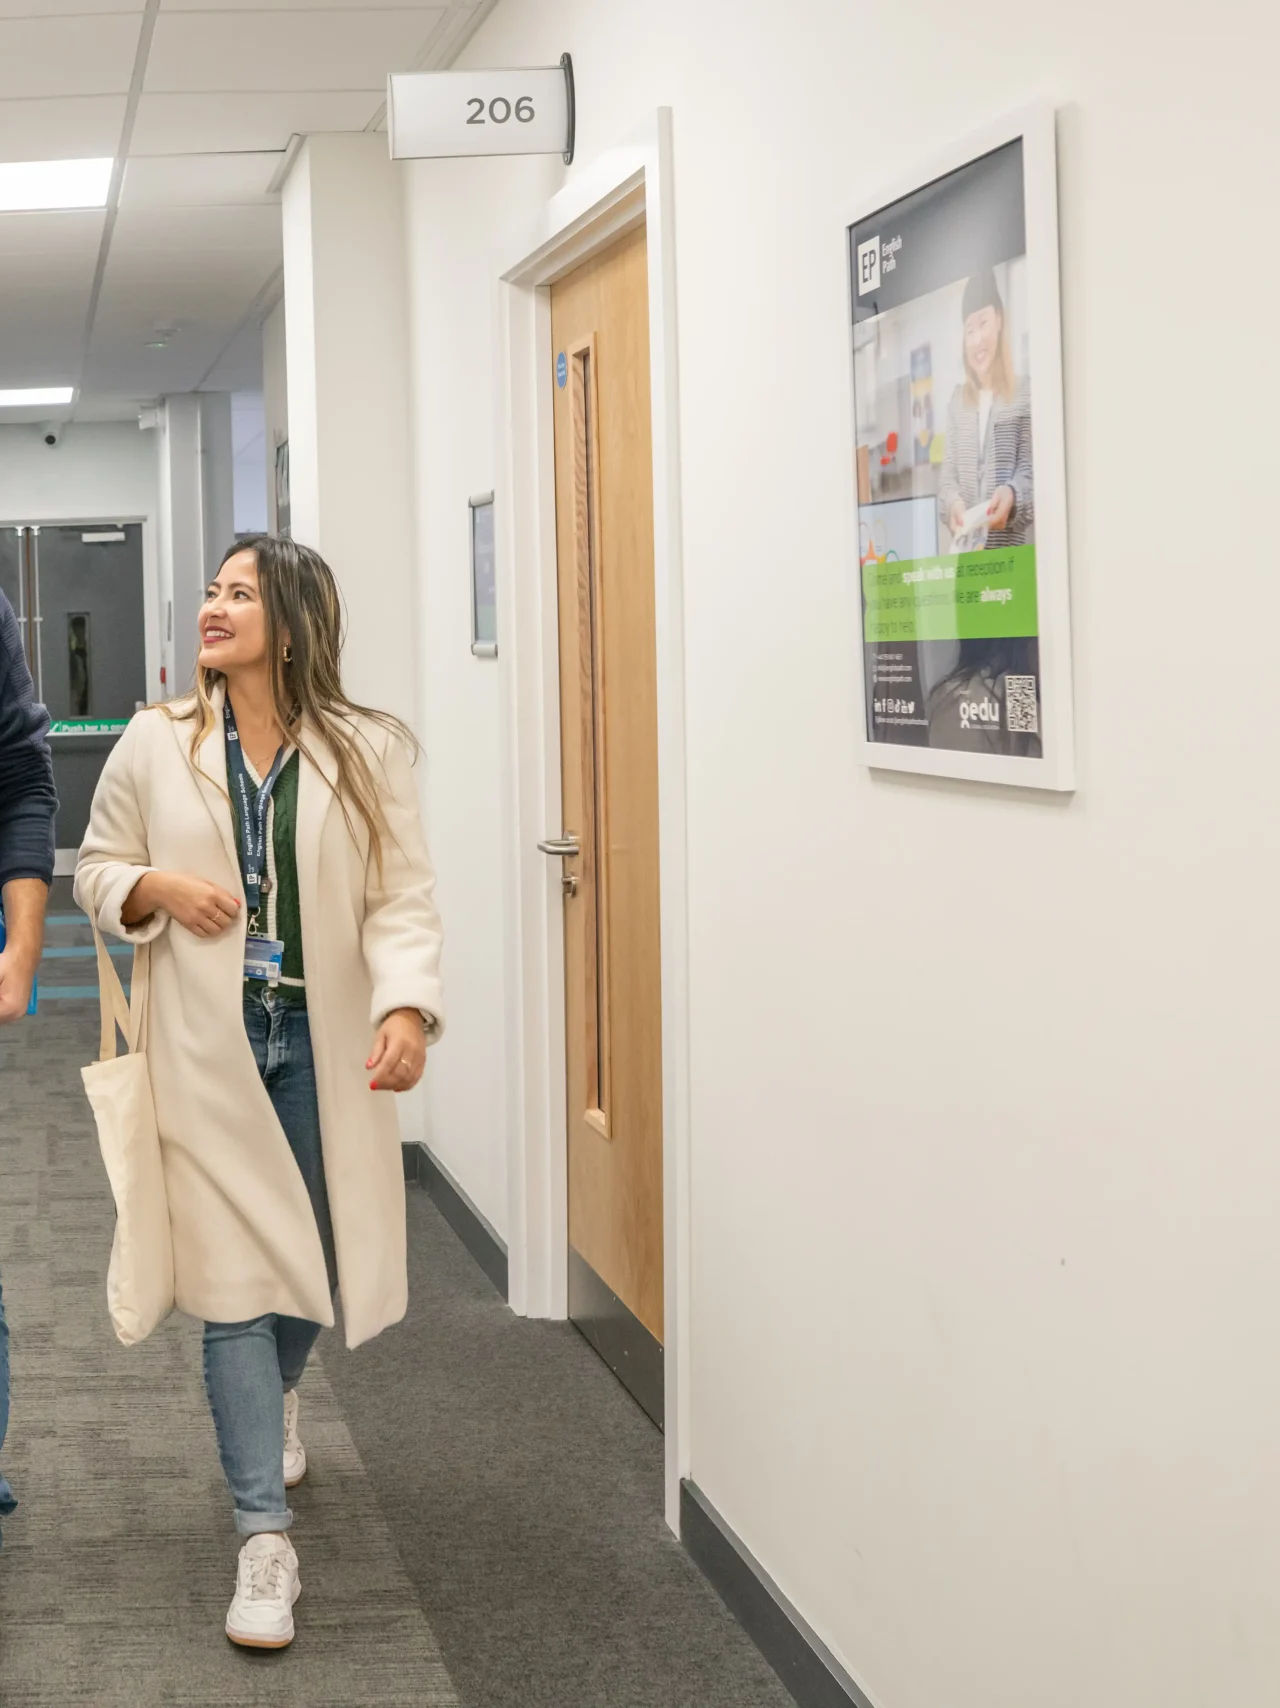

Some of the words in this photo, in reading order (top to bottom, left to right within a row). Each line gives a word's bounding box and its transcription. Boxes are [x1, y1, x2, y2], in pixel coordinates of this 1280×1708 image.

[466, 96, 535, 124] 206
[882, 235, 903, 258] English
[862, 249, 877, 284] EP
[882, 256, 896, 275] Path
[903, 567, 924, 587] speak
[925, 565, 943, 581] with
[944, 566, 955, 579] us
[956, 564, 964, 578] at
[966, 559, 1007, 578] reception
[882, 594, 898, 610] have
[898, 596, 911, 612] any
[966, 591, 980, 604] are
[980, 586, 1013, 605] always
[959, 696, 1000, 729] gedu
[62, 724, 83, 732] Push
[85, 724, 99, 732] bar
[100, 723, 109, 731] to
[238, 773, 246, 794] Schools
[242, 794, 250, 820] Language
[258, 793, 267, 821] Language
